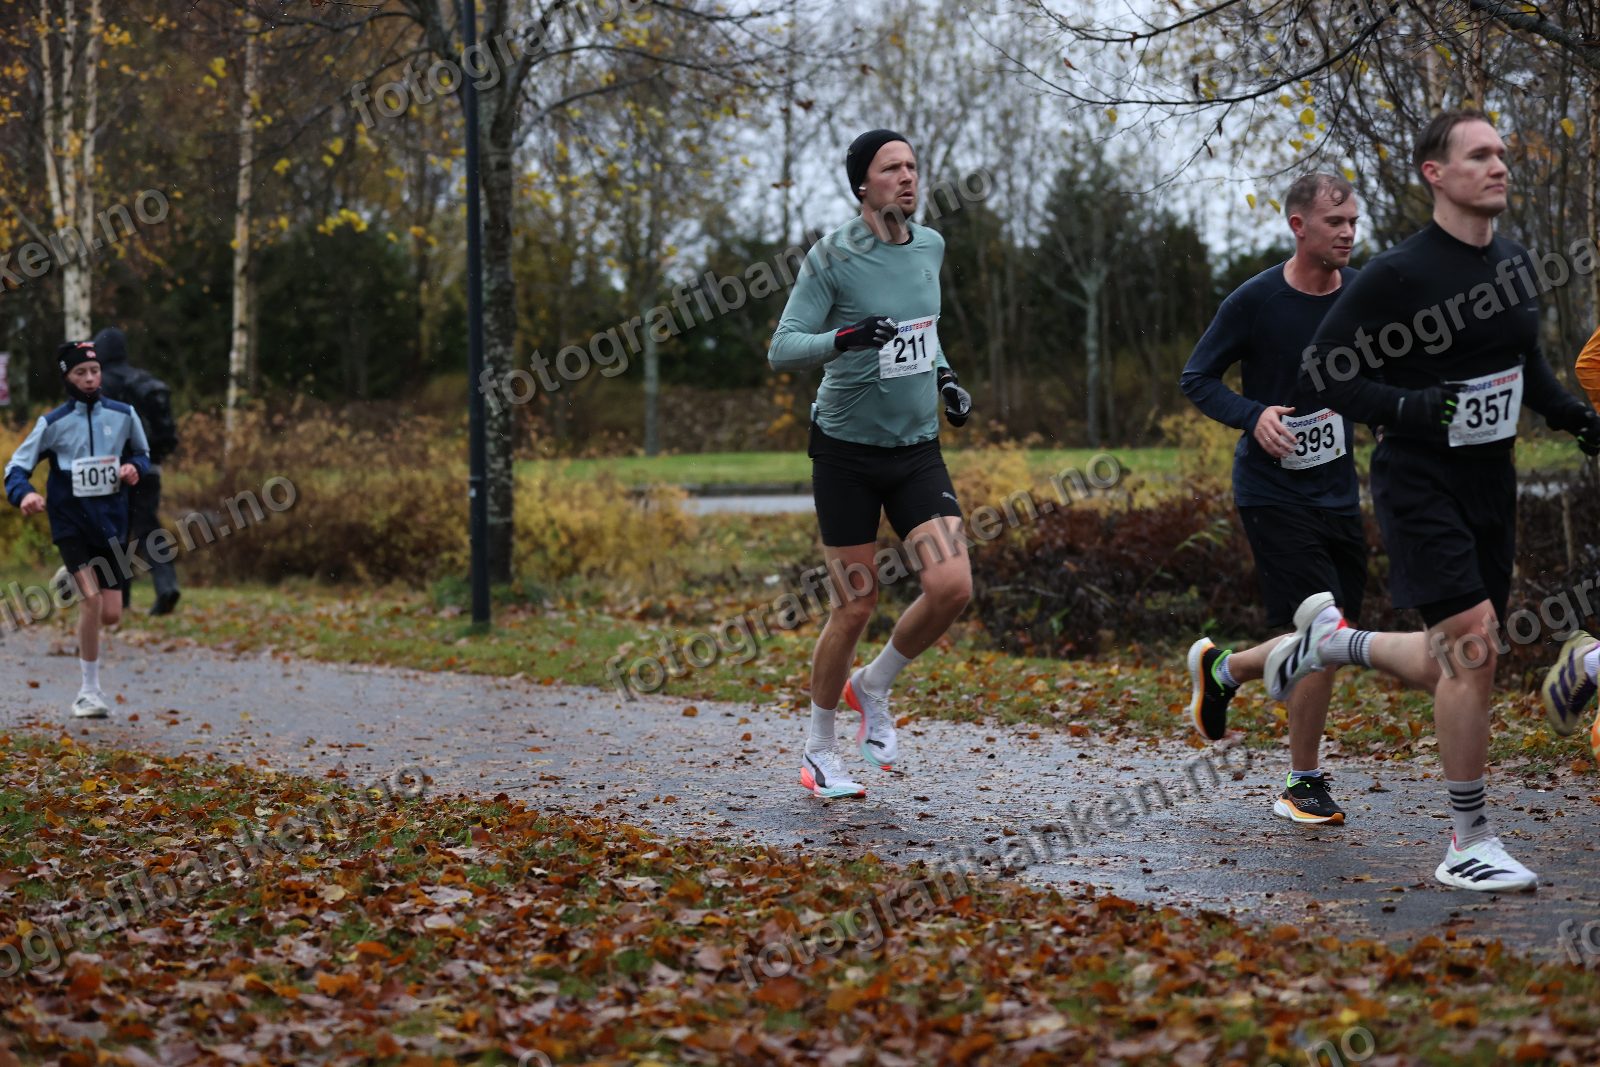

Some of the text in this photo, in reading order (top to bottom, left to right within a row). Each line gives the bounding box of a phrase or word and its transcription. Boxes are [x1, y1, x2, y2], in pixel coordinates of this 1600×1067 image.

[893, 332, 927, 364] 211
[1465, 388, 1513, 429] 357
[1294, 422, 1335, 457] 393
[78, 466, 118, 487] 1013
